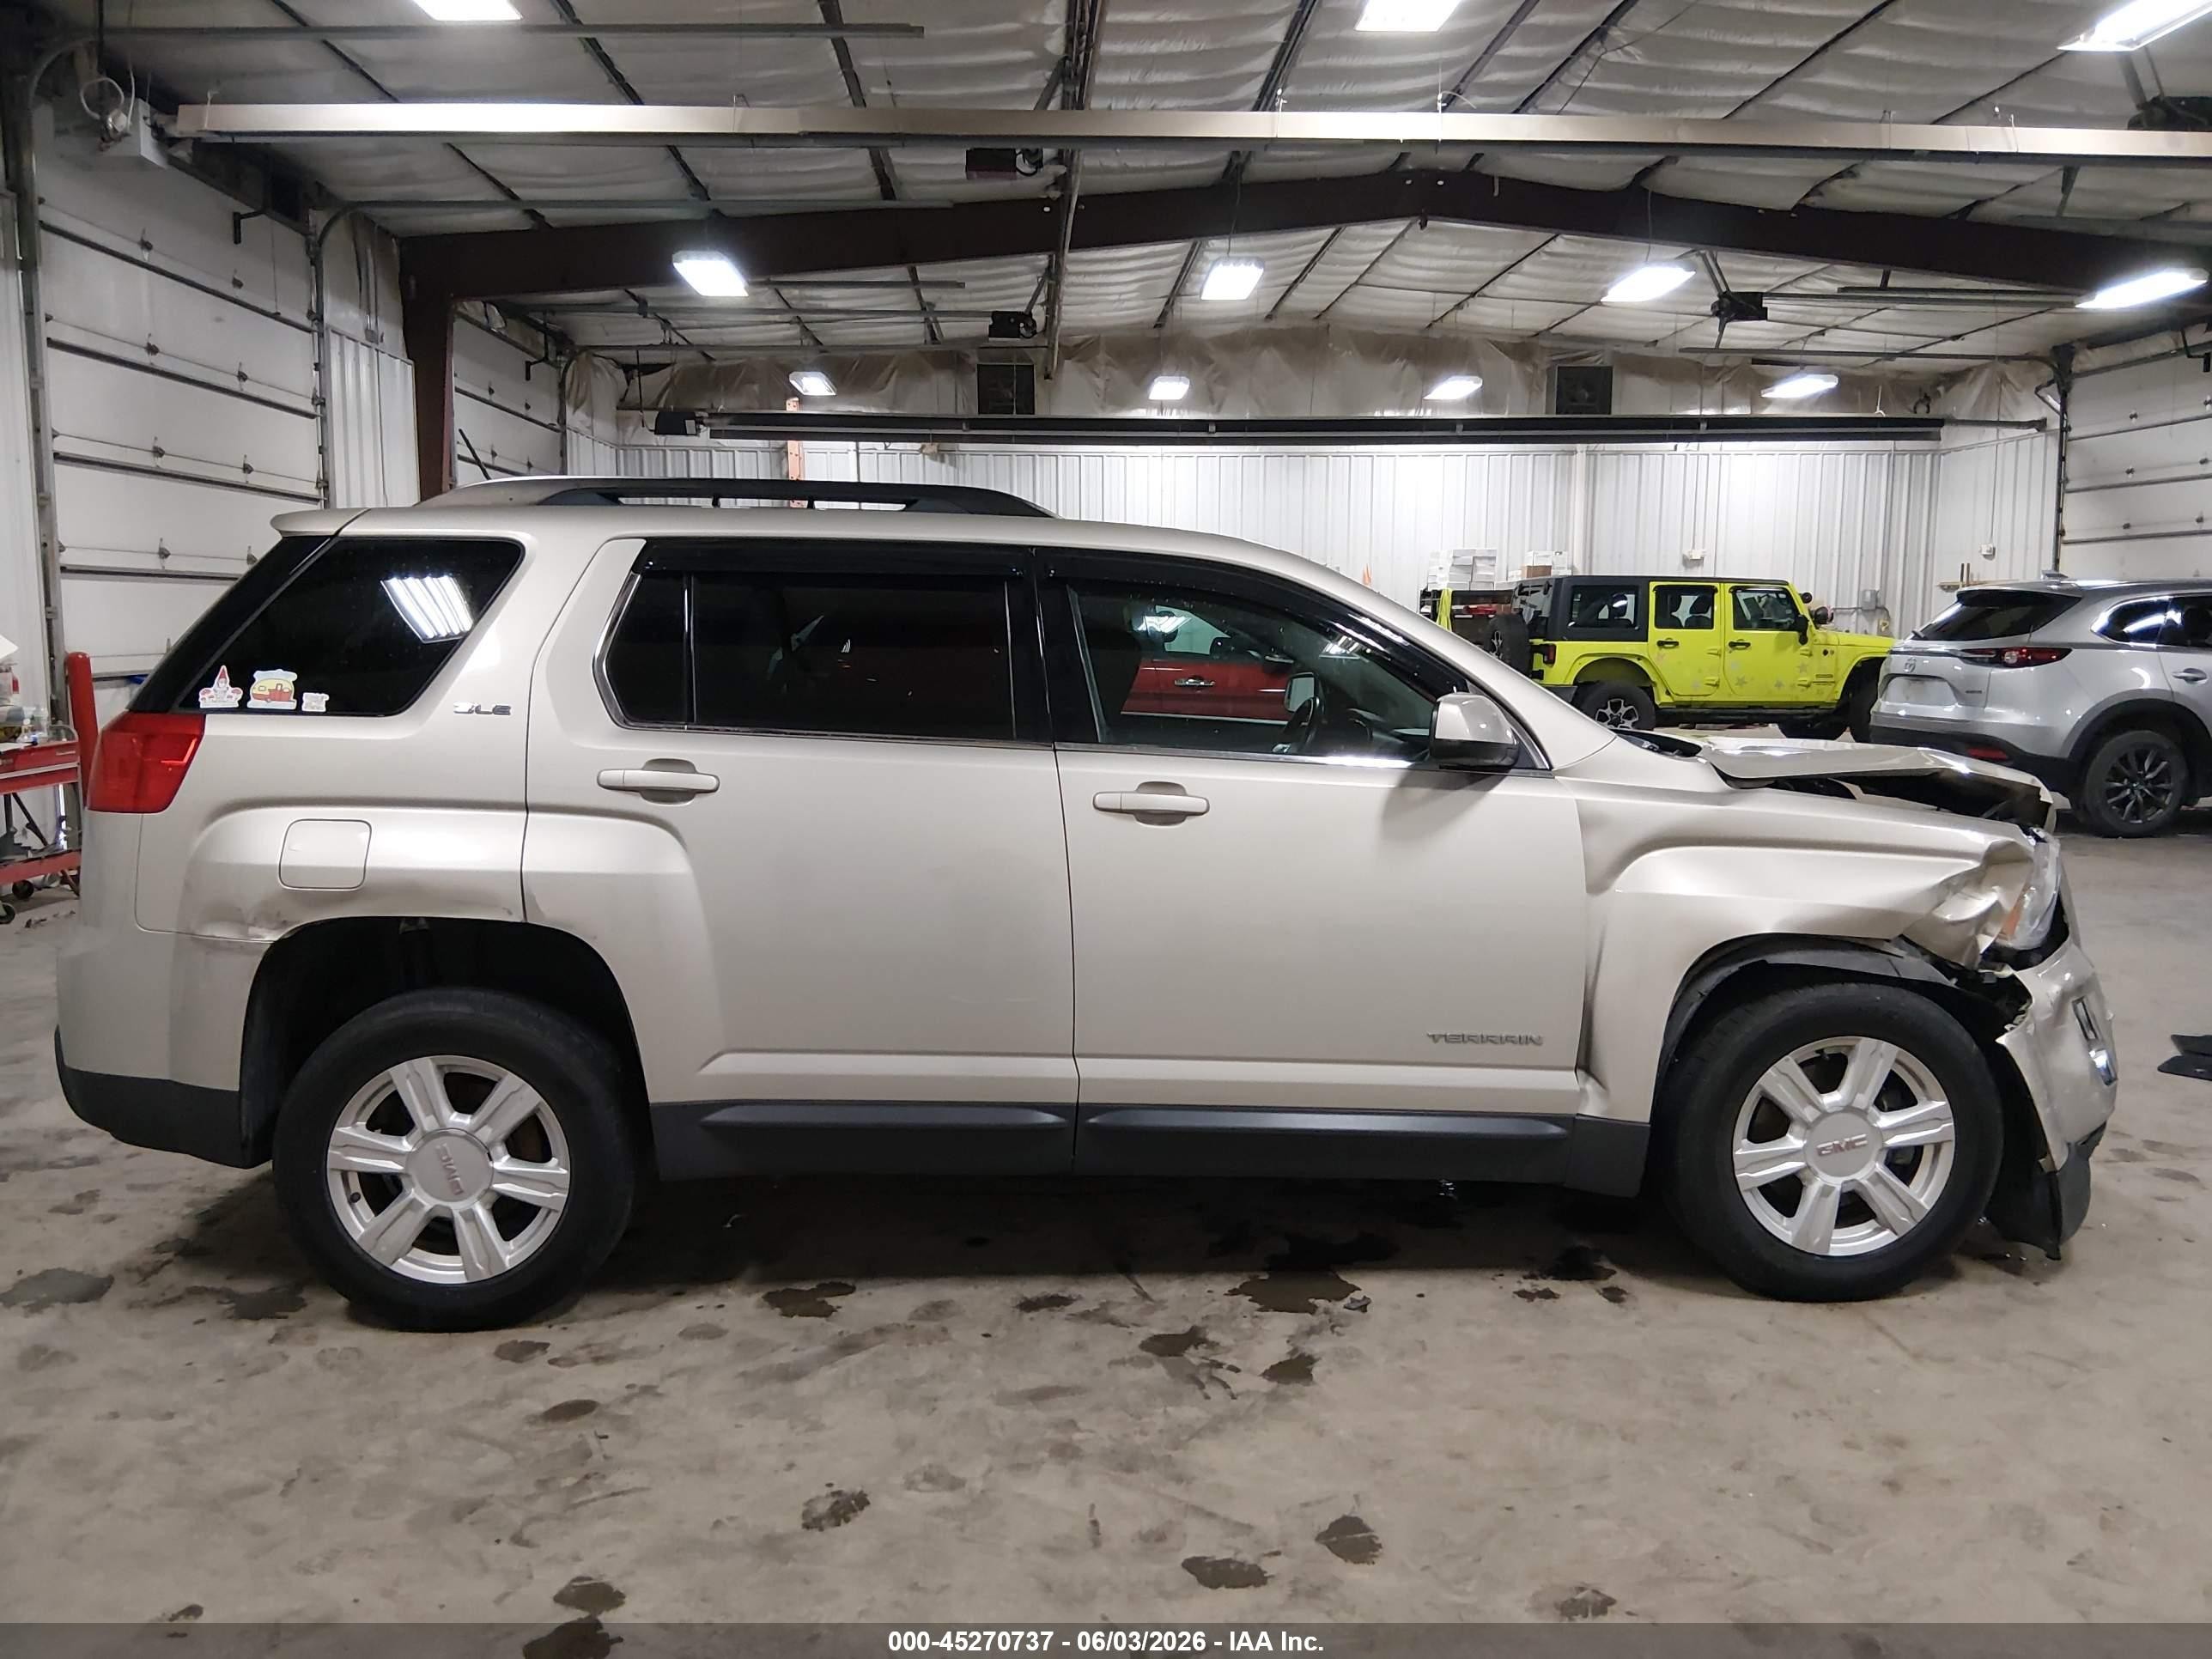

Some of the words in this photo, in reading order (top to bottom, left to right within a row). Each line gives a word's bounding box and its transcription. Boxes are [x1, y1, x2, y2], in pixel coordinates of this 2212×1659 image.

[1426, 1032, 1544, 1046] TERRAIN
[1816, 1133, 1869, 1156] GMC
[434, 1143, 465, 1195] GMC
